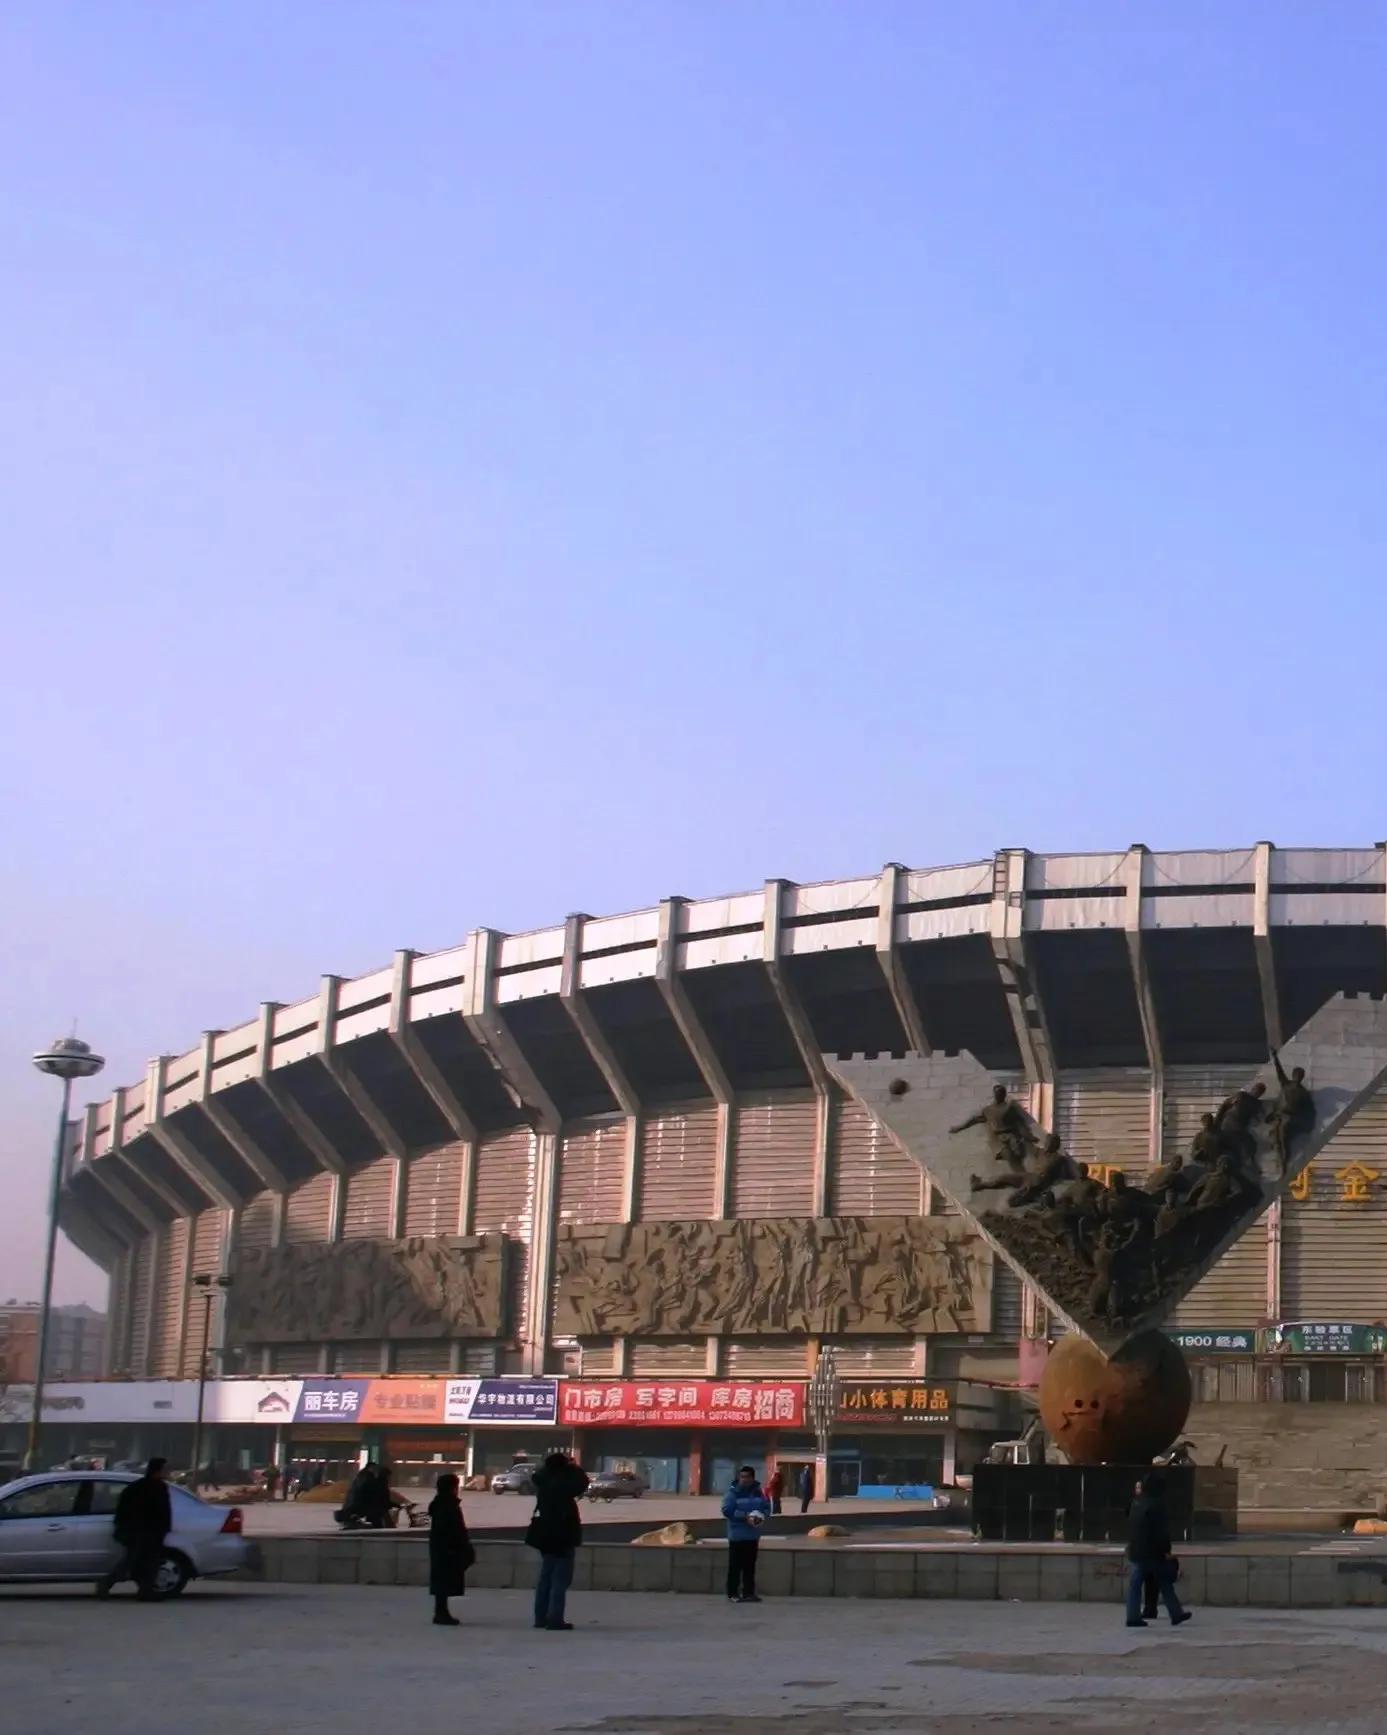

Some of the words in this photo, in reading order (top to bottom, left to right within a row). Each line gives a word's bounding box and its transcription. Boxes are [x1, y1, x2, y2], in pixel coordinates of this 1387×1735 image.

[1177, 1335, 1212, 1347] 1900
[303, 1390, 359, 1412] 丽车房
[564, 1386, 623, 1409] 门市房
[634, 1386, 697, 1408] 写字间
[710, 1386, 753, 1408] 库房
[753, 1388, 795, 1421] 招商
